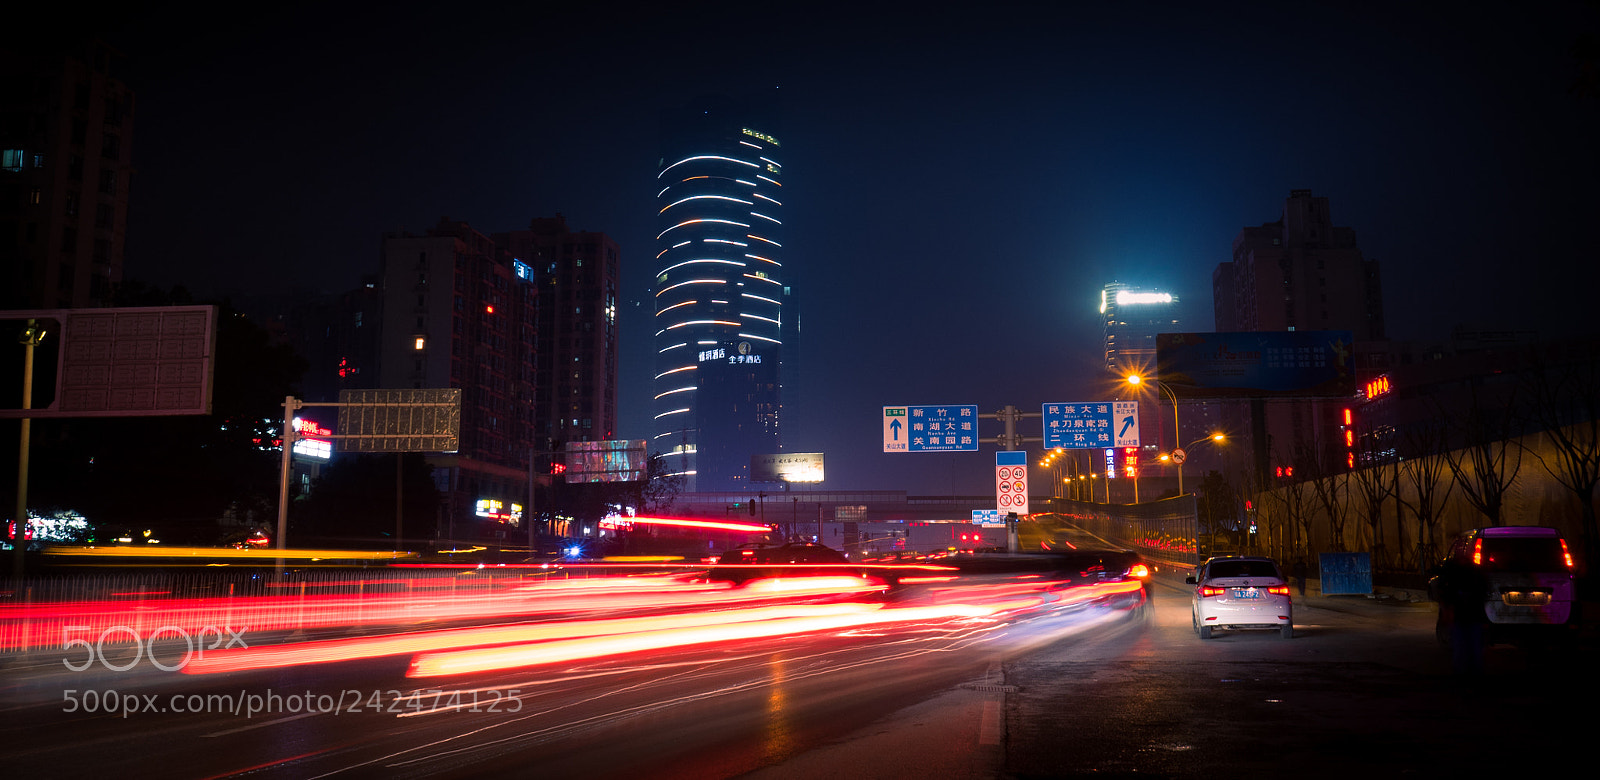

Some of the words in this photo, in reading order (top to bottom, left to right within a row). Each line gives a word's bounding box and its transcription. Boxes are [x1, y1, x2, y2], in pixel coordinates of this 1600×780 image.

[729, 355, 761, 364] 全季酒店
[913, 408, 971, 417] 新竹路
[1049, 405, 1108, 414] 民族大道
[913, 422, 971, 430] 南湖大道
[1050, 420, 1108, 428] 卓刀泉南路
[913, 437, 972, 445] 关南园路
[1050, 434, 1109, 442] 二环线
